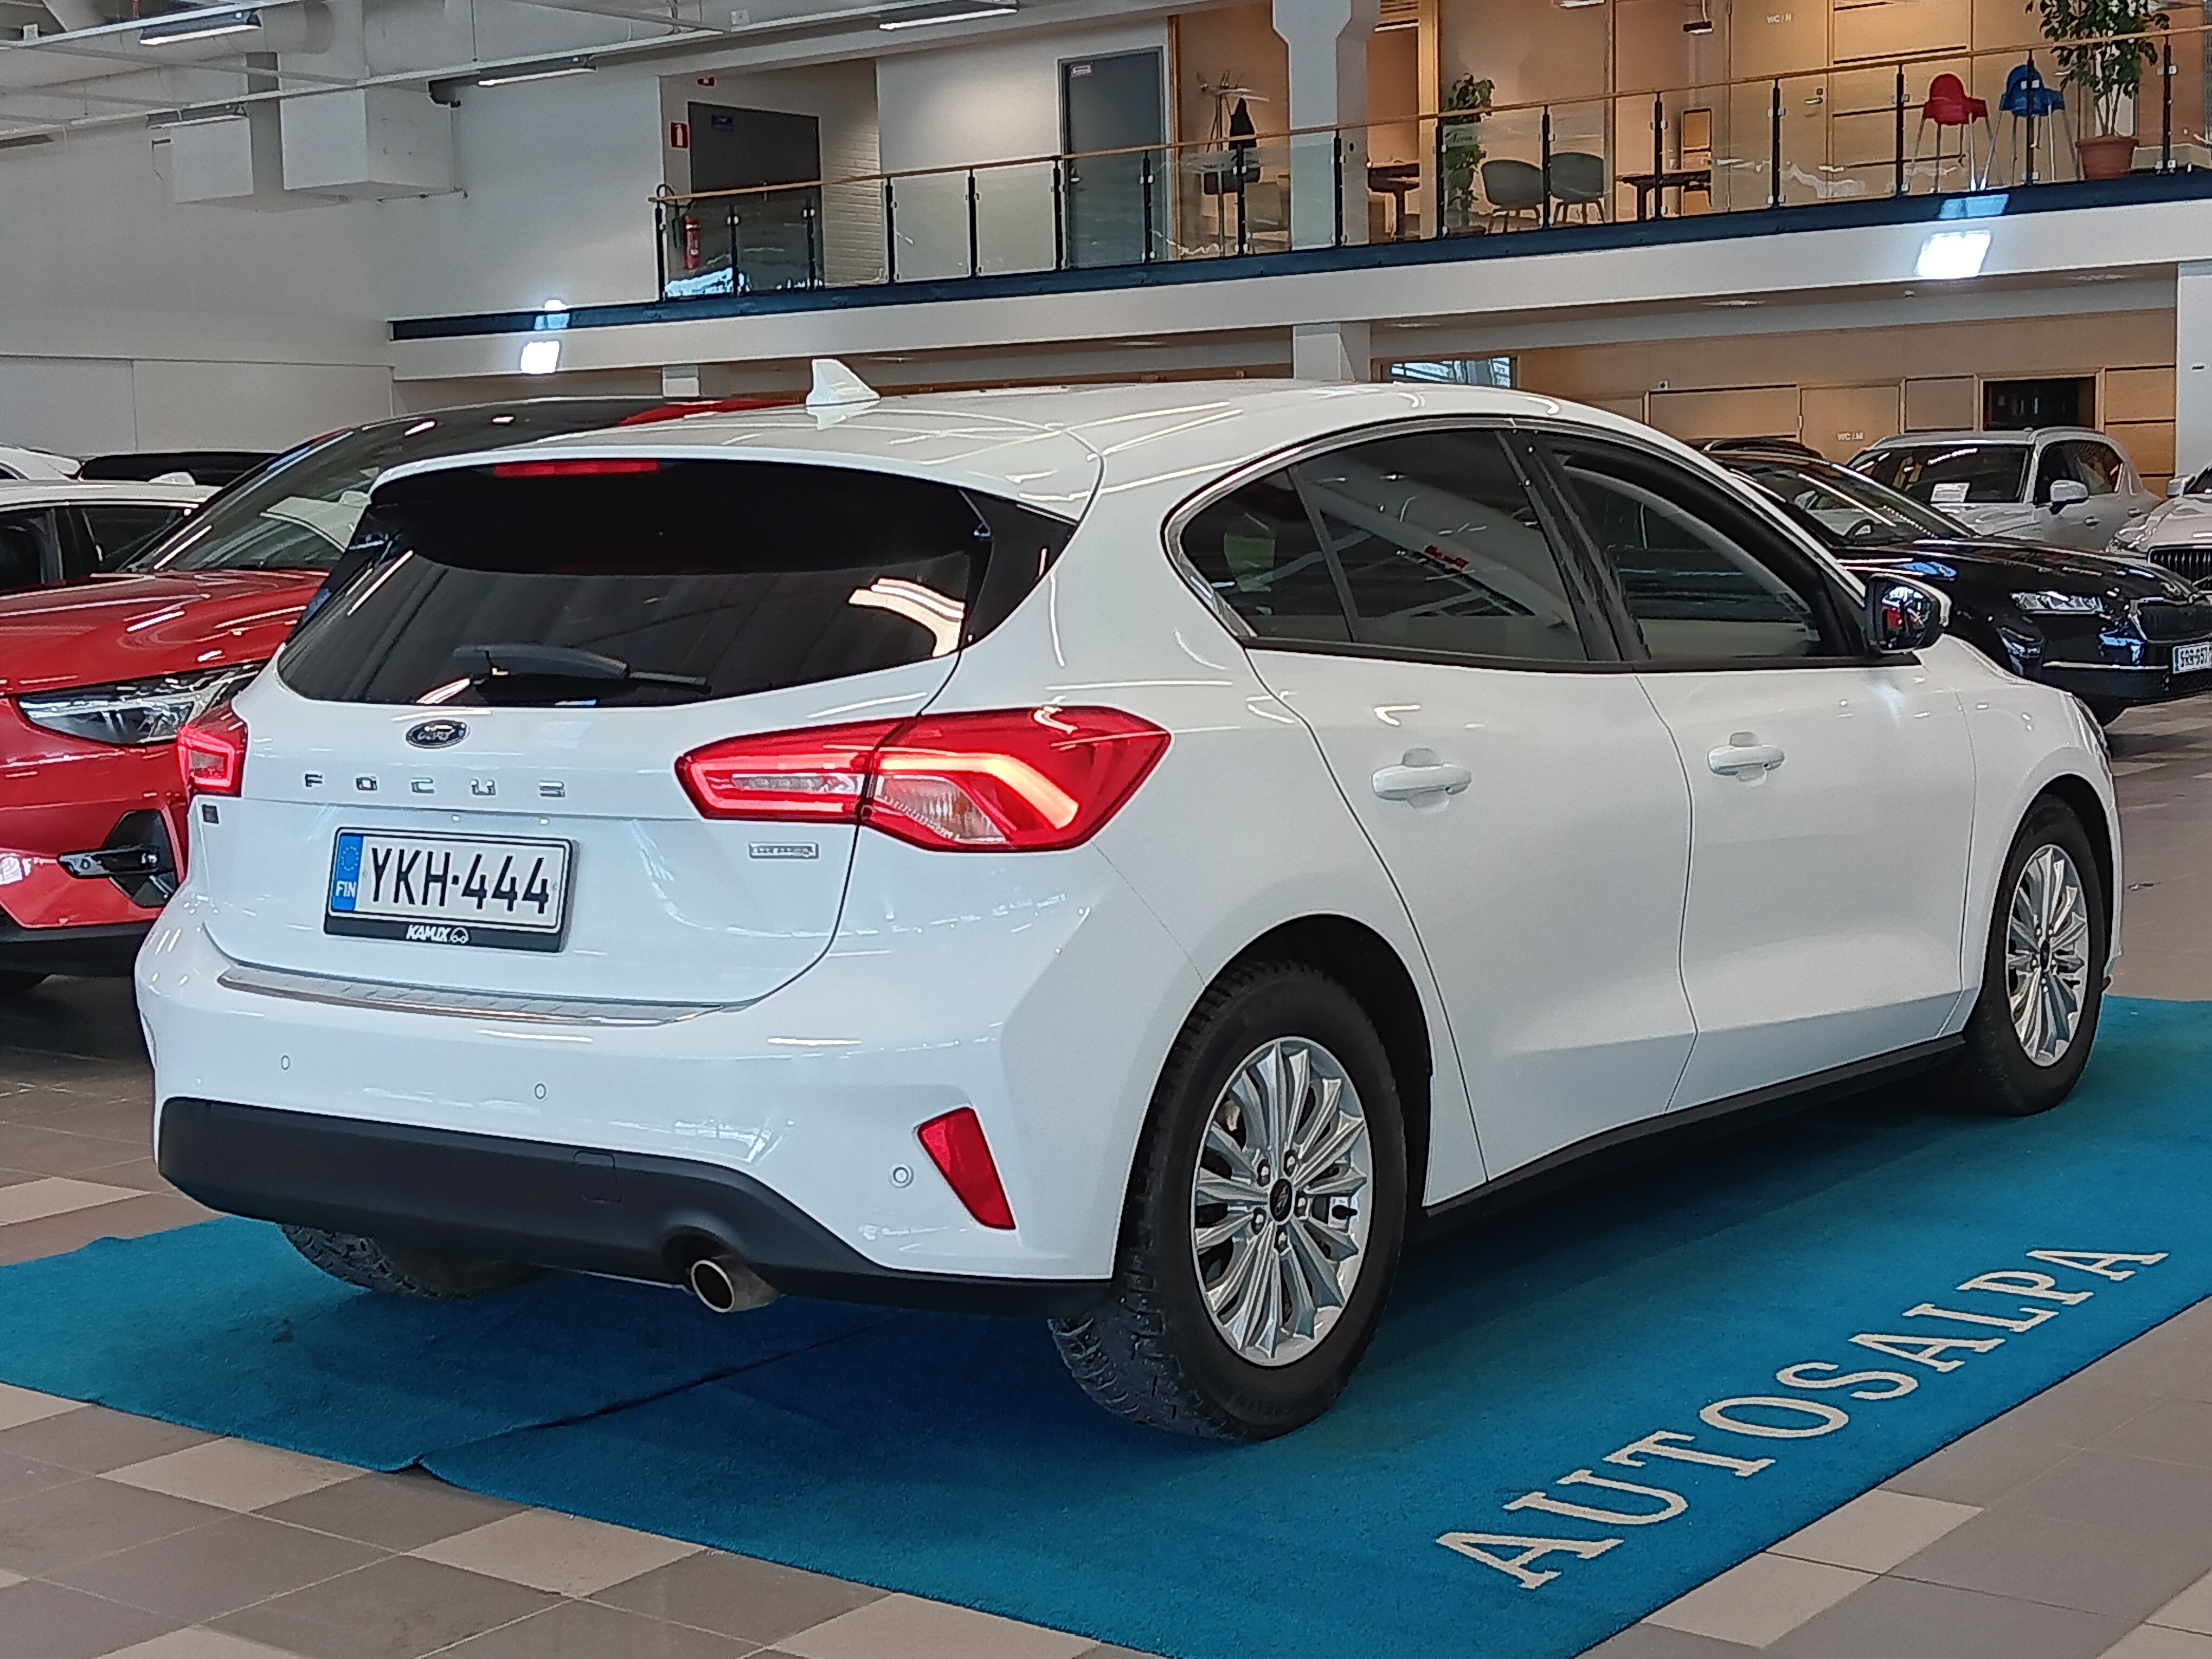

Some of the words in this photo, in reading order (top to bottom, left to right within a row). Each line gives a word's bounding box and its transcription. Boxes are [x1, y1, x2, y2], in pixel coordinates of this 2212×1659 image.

[304, 773, 565, 798] FOCUS
[335, 881, 356, 898] FIN
[406, 924, 452, 942] KAMUX
[1436, 1249, 2169, 1589] AUTOSALPA
